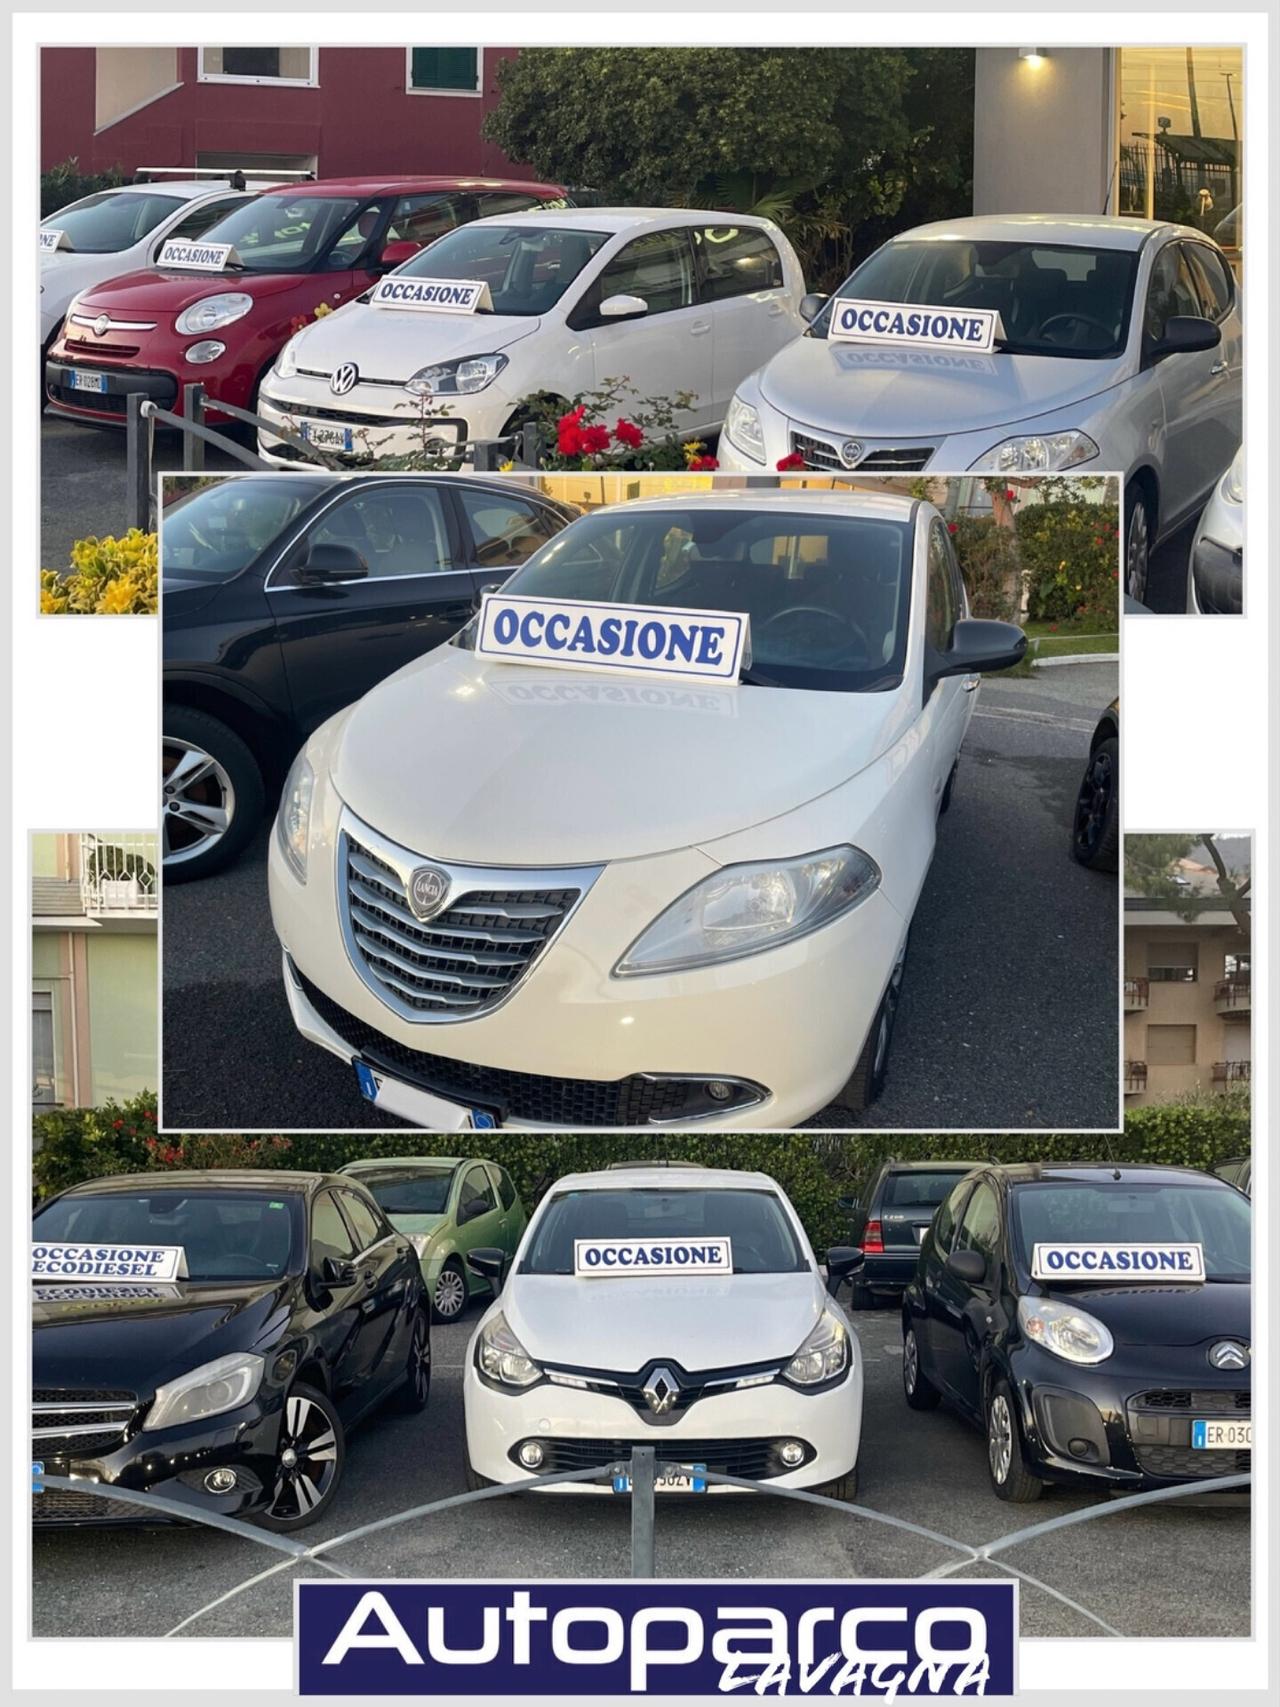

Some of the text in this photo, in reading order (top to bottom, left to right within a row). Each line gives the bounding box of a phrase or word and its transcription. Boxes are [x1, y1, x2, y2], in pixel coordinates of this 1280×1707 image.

[164, 247, 224, 265] OCCASIONE
[380, 282, 474, 305] OCCASIONE
[841, 308, 984, 342] OCCASIONE
[493, 608, 725, 666] OCCASIONE
[416, 880, 439, 897] LANCIA
[32, 1247, 165, 1263] OCCASIONE
[584, 1245, 723, 1267] OCCASIONE
[1046, 1250, 1194, 1271] OCCASIONE
[32, 1260, 158, 1276] ECODIESEL
[1207, 1426, 1225, 1443] ER
